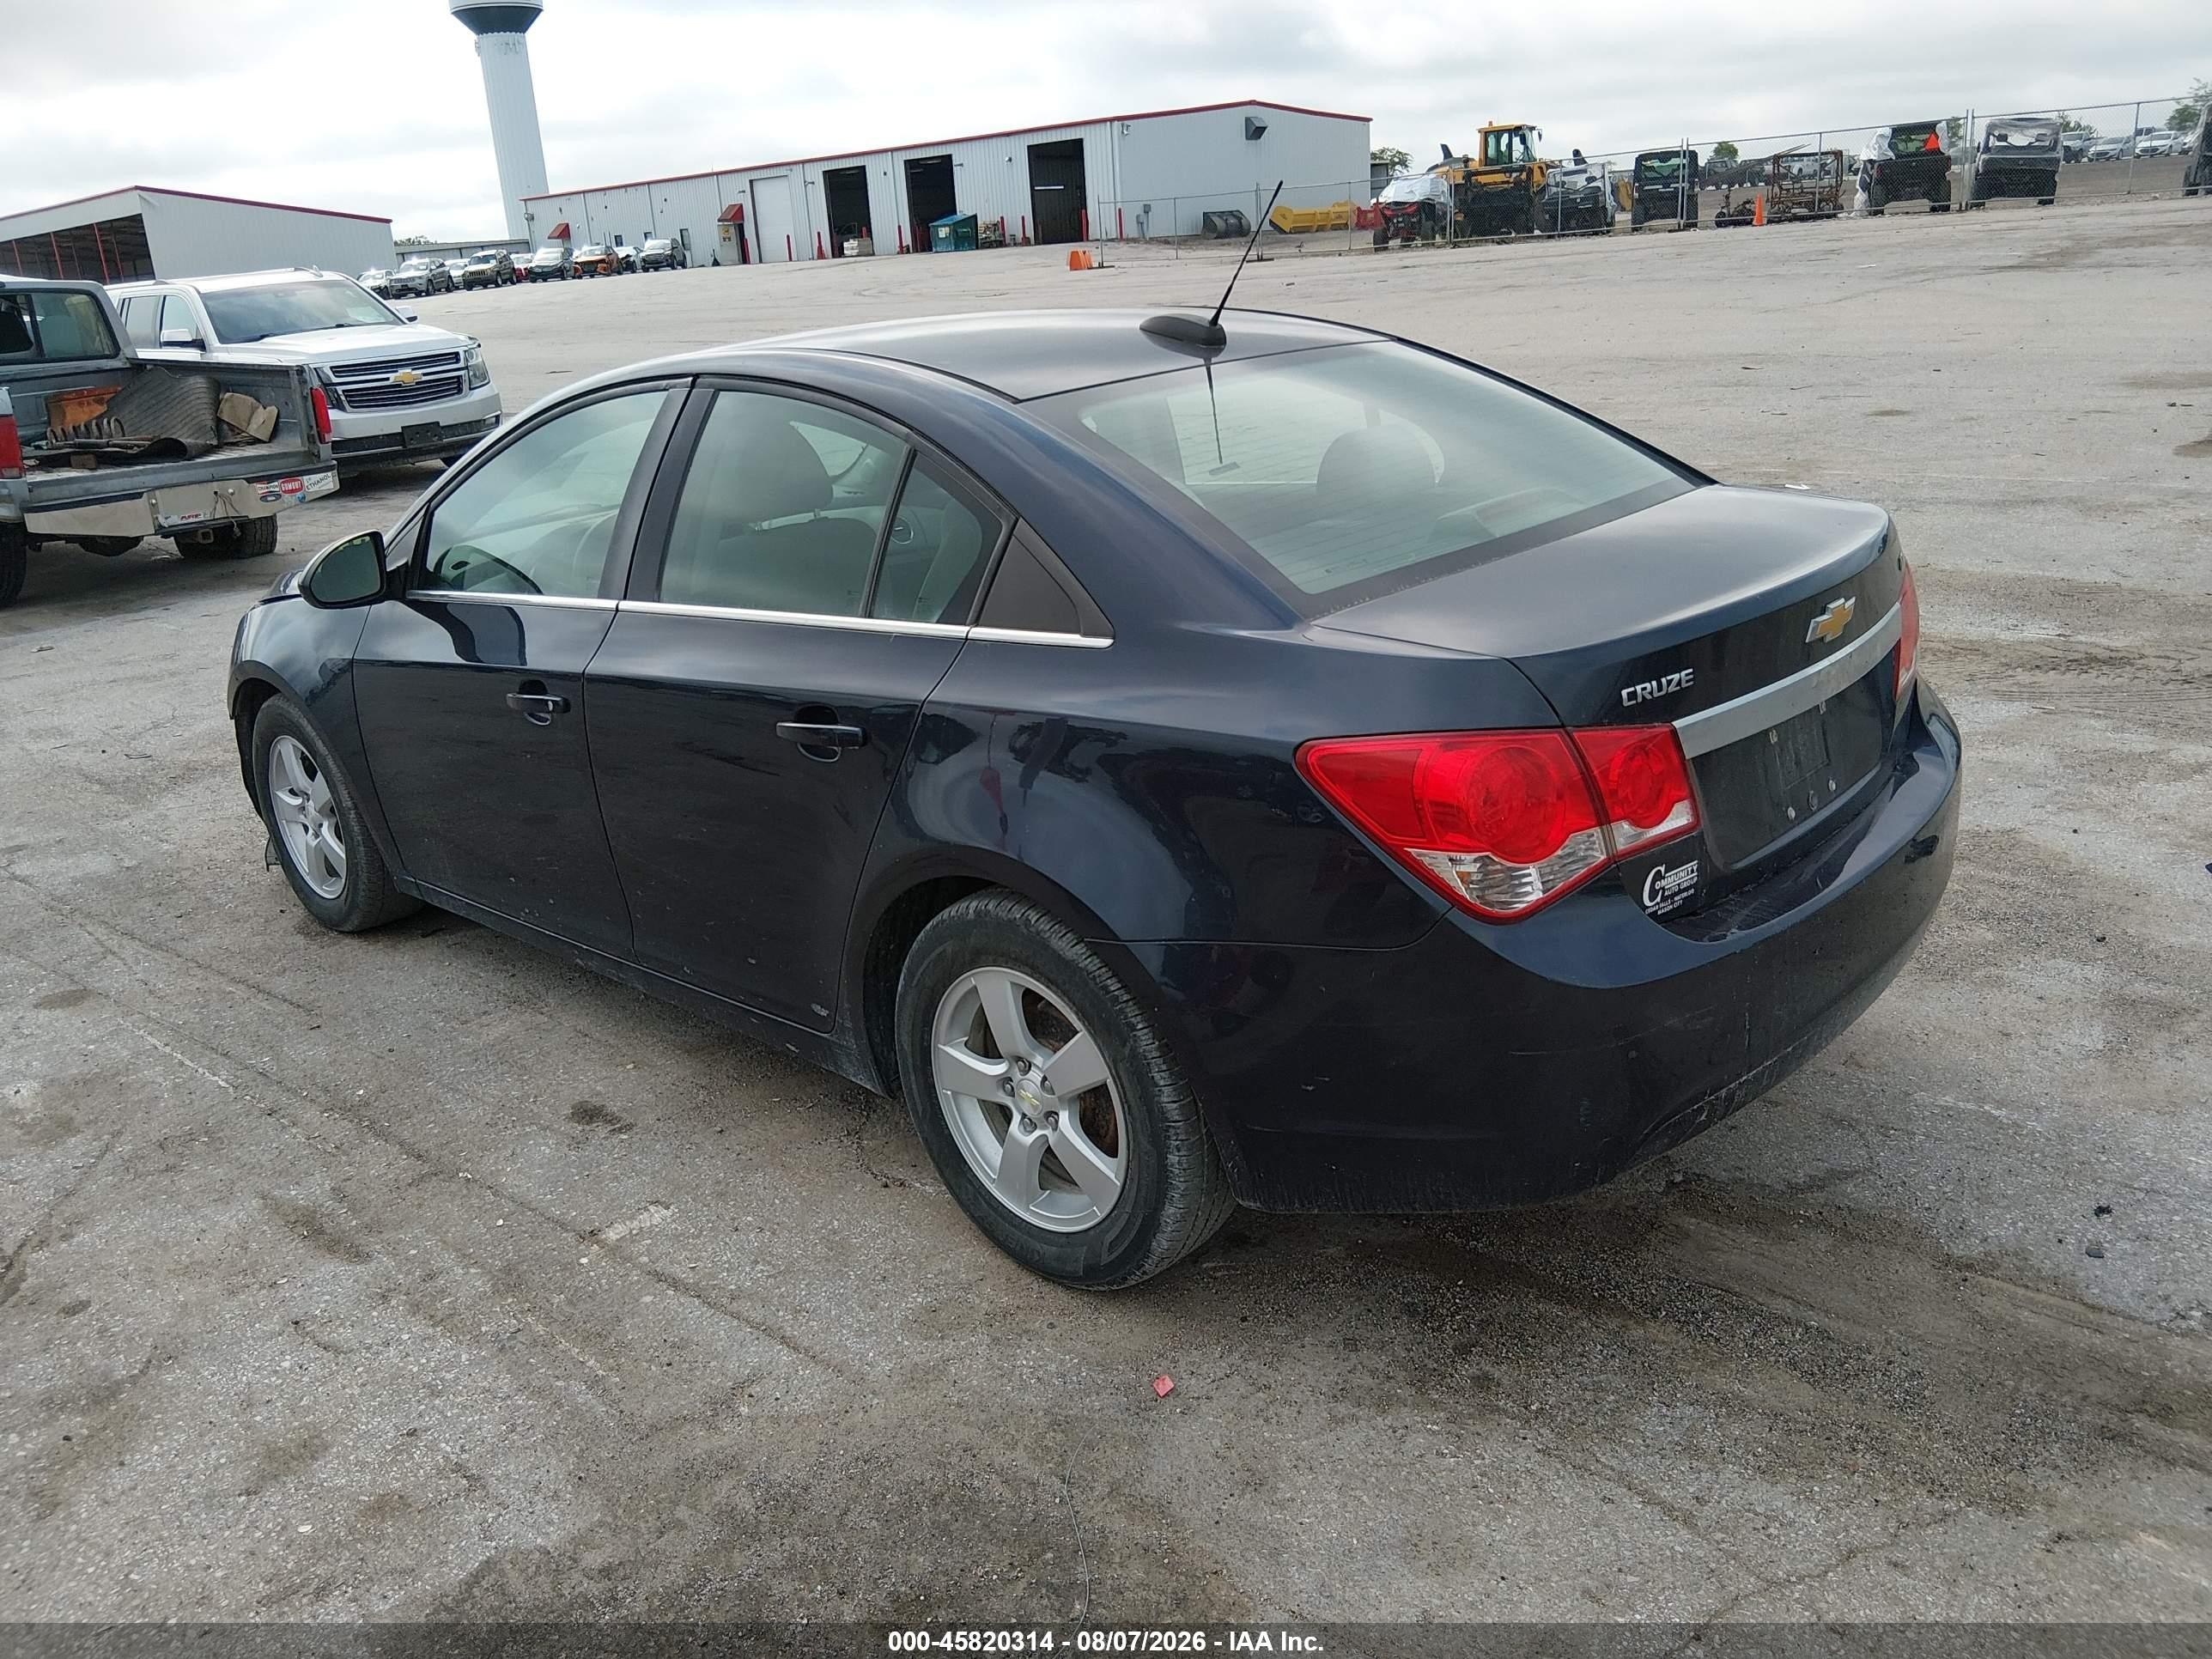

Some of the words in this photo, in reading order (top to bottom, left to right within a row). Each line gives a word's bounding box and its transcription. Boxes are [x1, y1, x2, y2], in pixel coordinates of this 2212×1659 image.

[306, 473, 331, 490] ETHANOL
[1621, 668, 1694, 707] CRUZE
[1643, 864, 1698, 906] COMMUNITY
[1664, 885, 1679, 896] AUTO
[1680, 876, 1698, 890] GROUP
